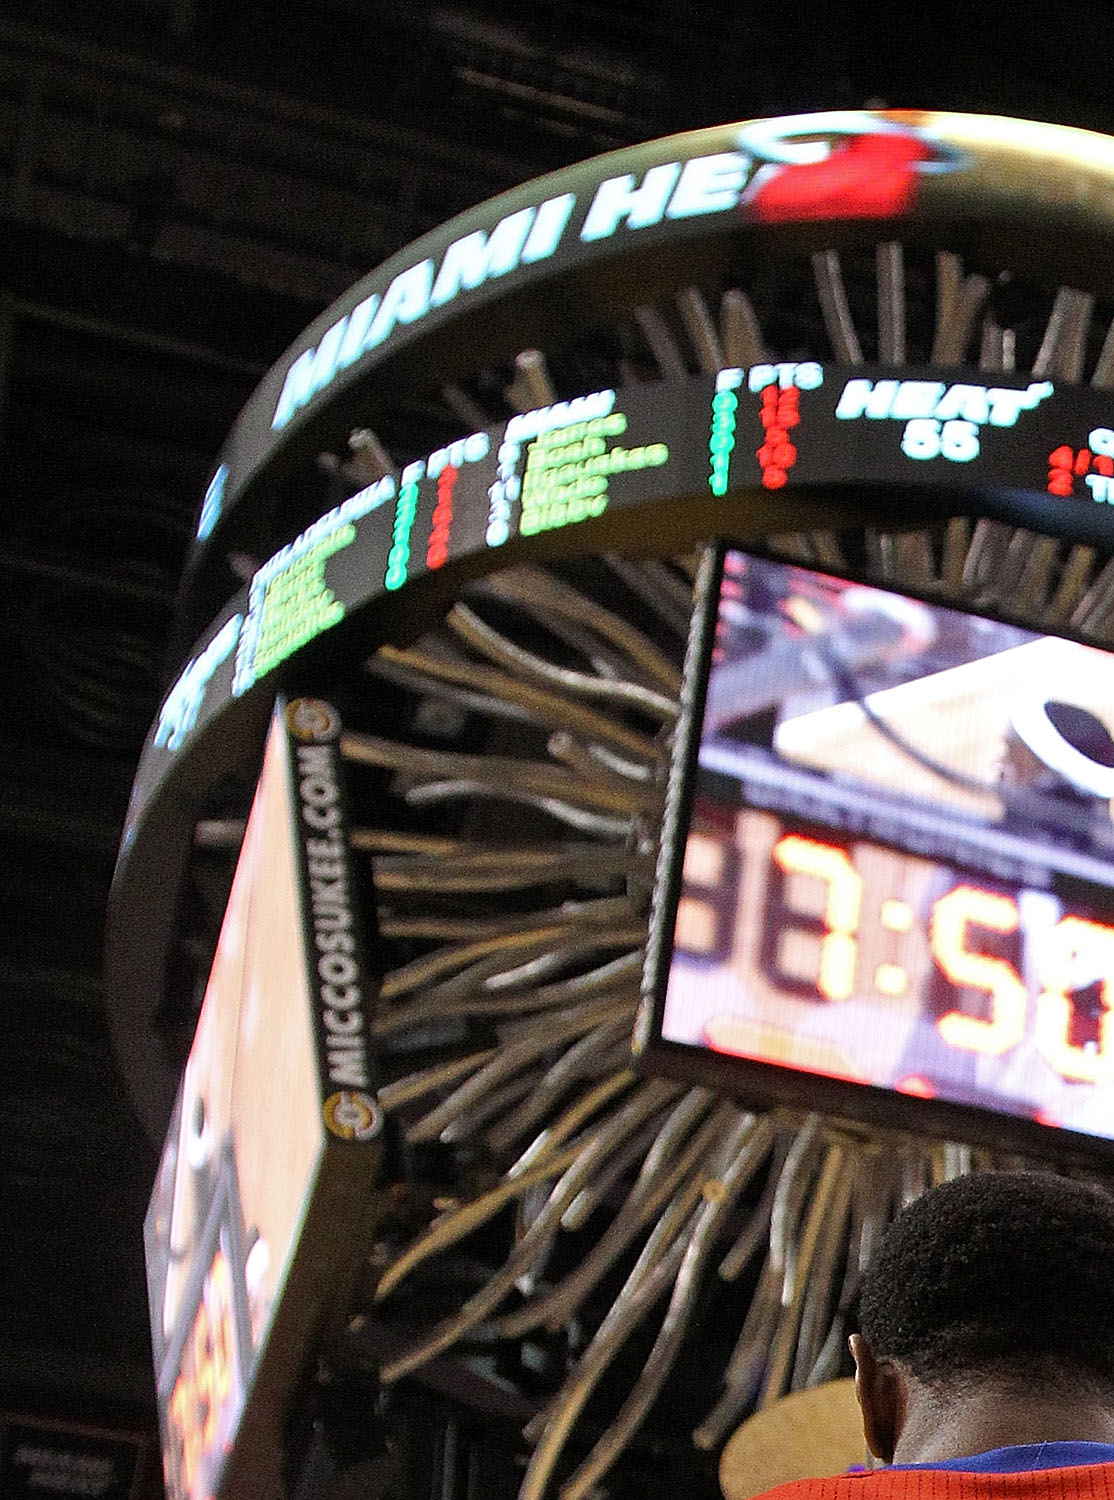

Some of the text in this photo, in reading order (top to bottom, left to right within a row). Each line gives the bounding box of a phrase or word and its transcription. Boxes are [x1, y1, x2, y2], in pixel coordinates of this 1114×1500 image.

[271, 192, 576, 431] MIAMI
[836, 378, 1054, 426] HEAT
[298, 744, 369, 1088] MICCOSUKEE.COM
